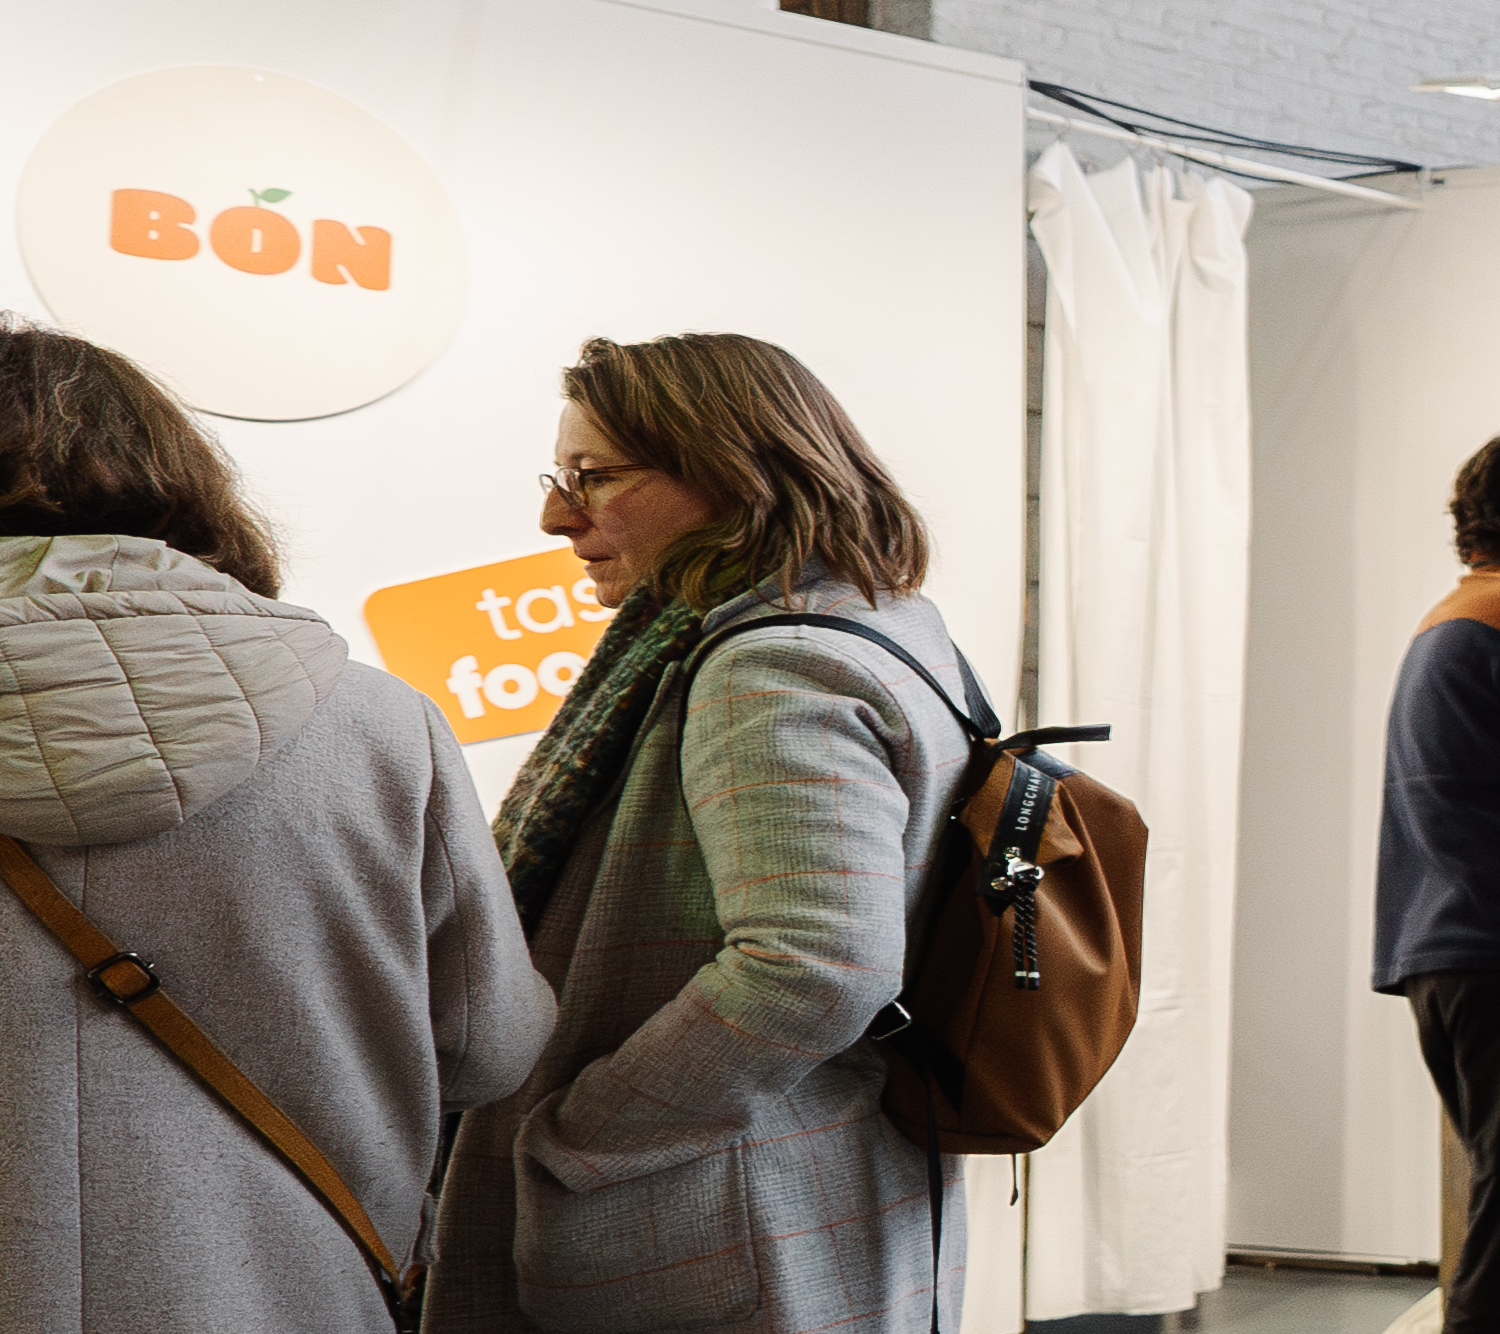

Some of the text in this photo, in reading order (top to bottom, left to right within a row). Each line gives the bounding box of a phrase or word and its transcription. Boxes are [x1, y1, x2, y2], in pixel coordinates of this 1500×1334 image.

[109, 188, 393, 291] BON
[475, 575, 617, 642] tas
[446, 651, 586, 719] foo
